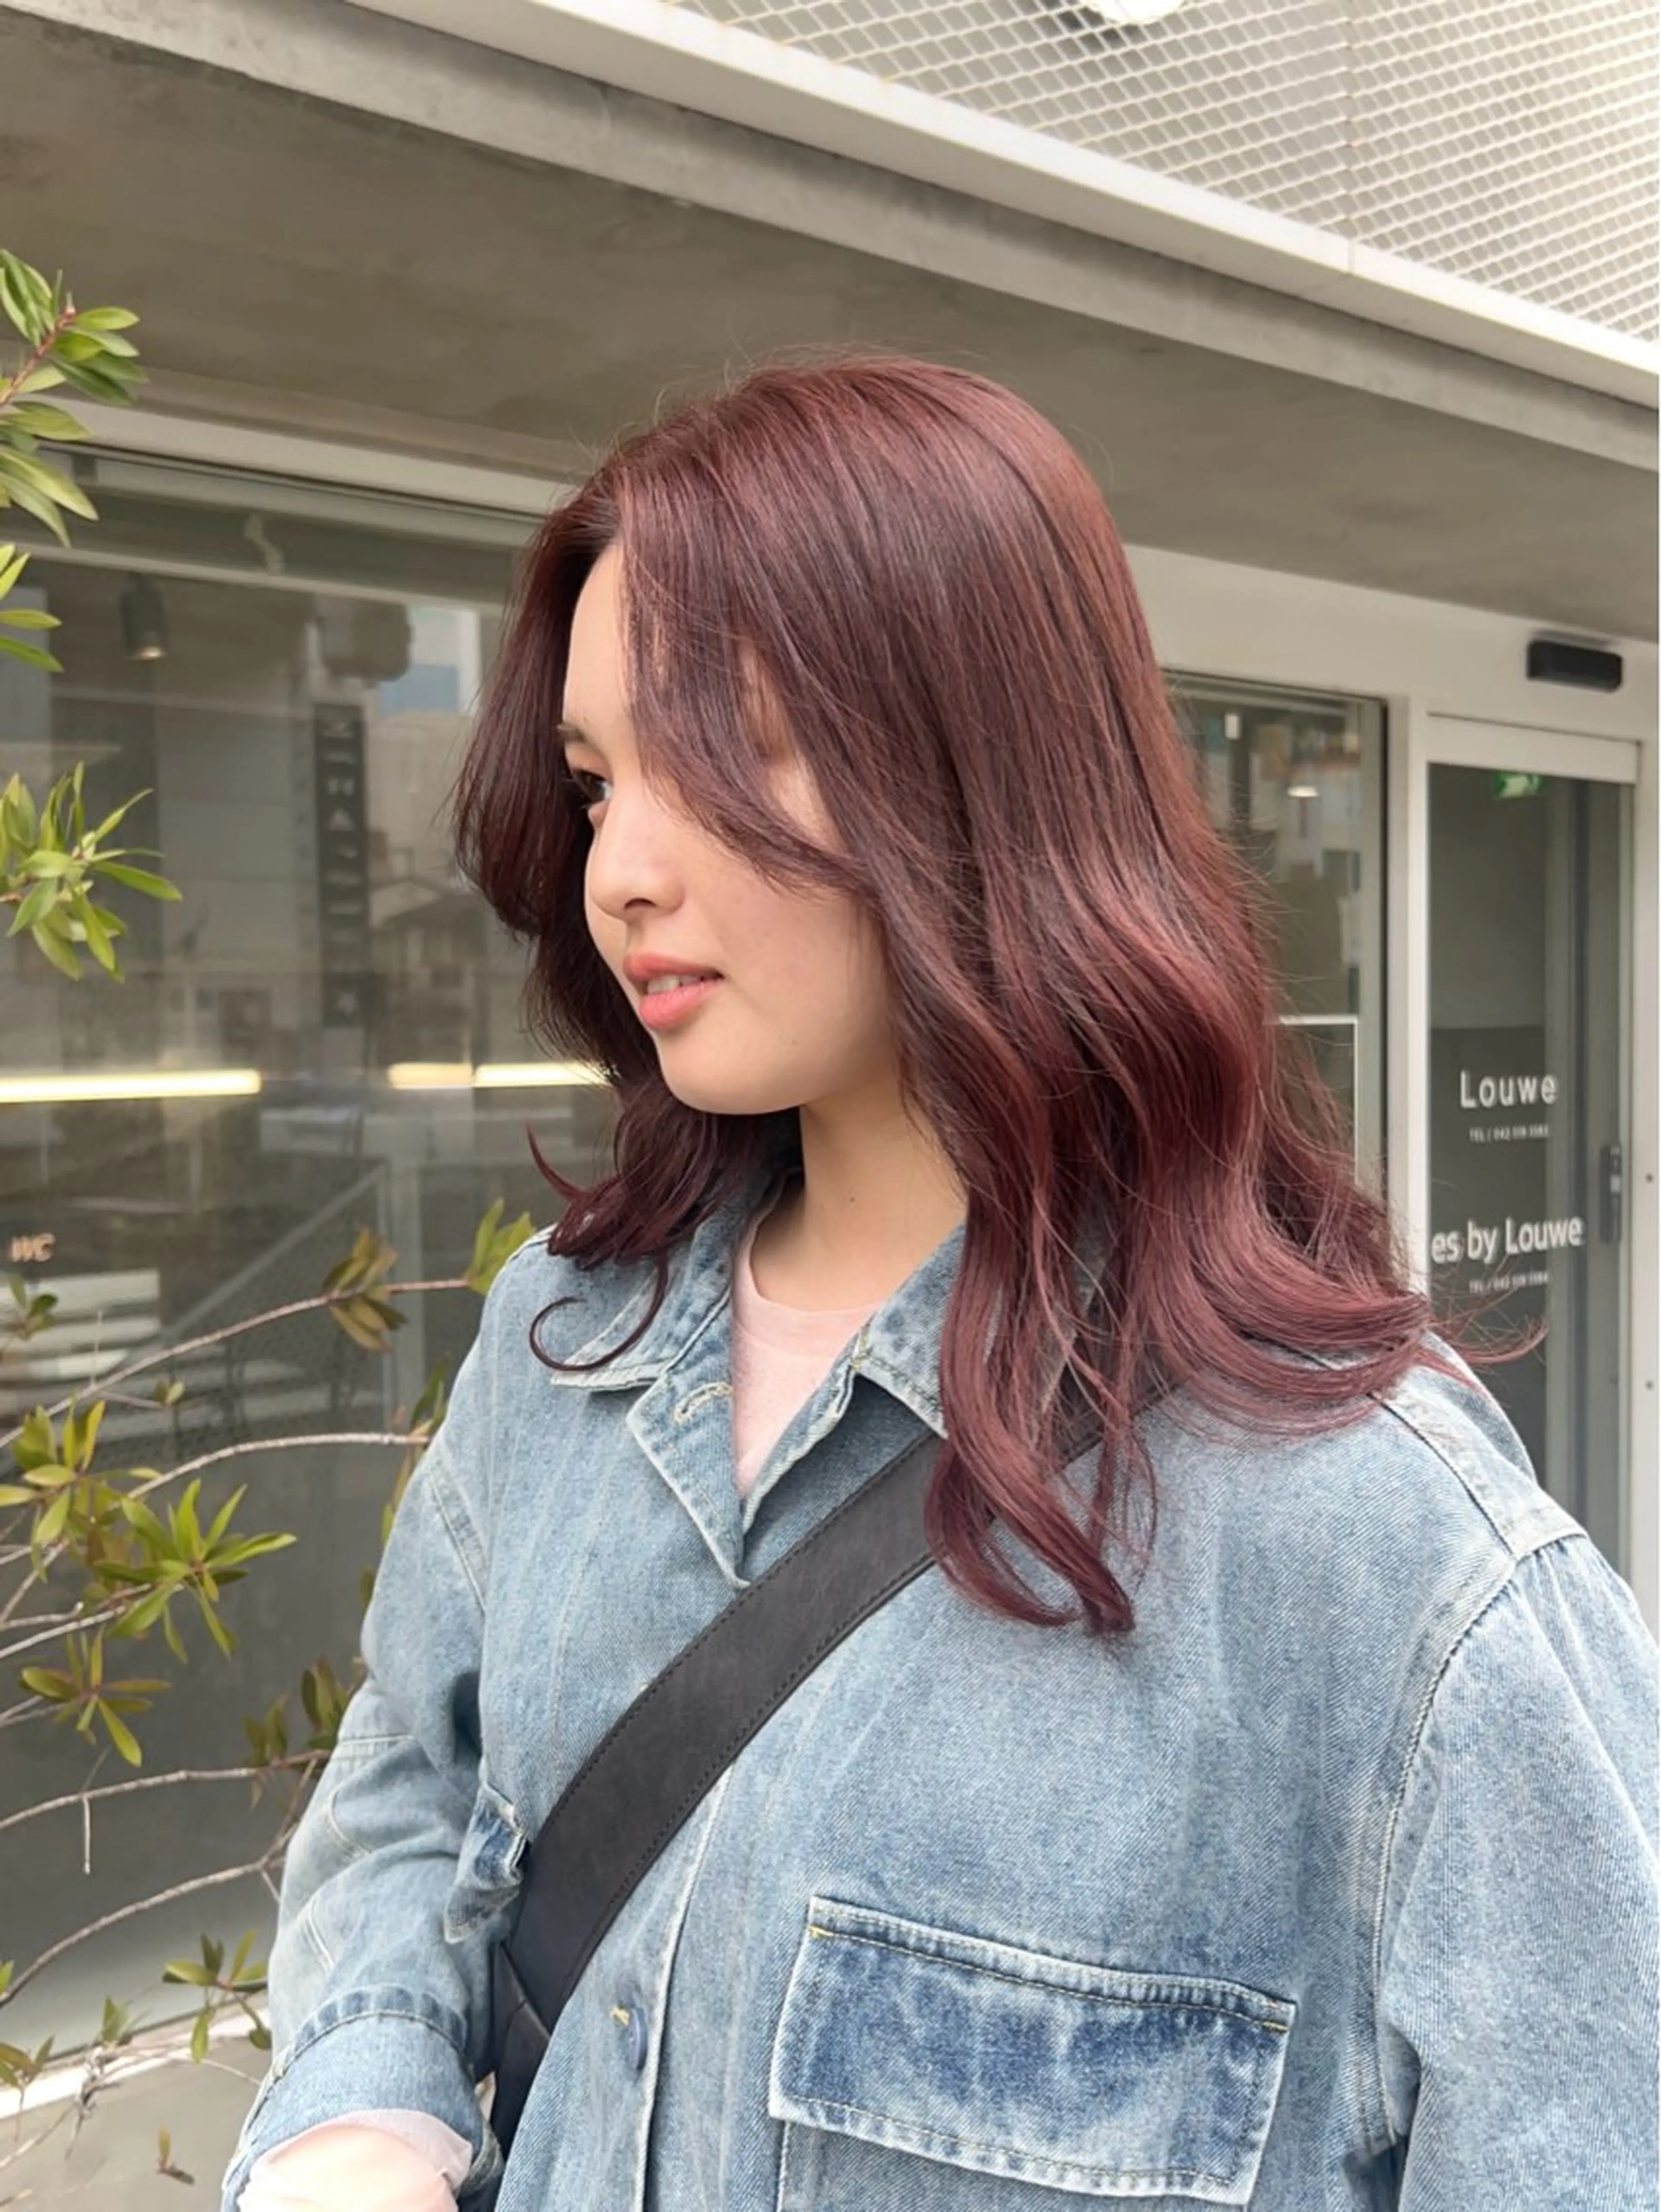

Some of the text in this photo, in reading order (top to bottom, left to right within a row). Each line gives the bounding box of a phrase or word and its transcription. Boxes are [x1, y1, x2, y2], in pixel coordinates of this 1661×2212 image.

[1460, 1070, 1557, 1109] Louwe
[1431, 1215, 1583, 1265] es by Louwe
